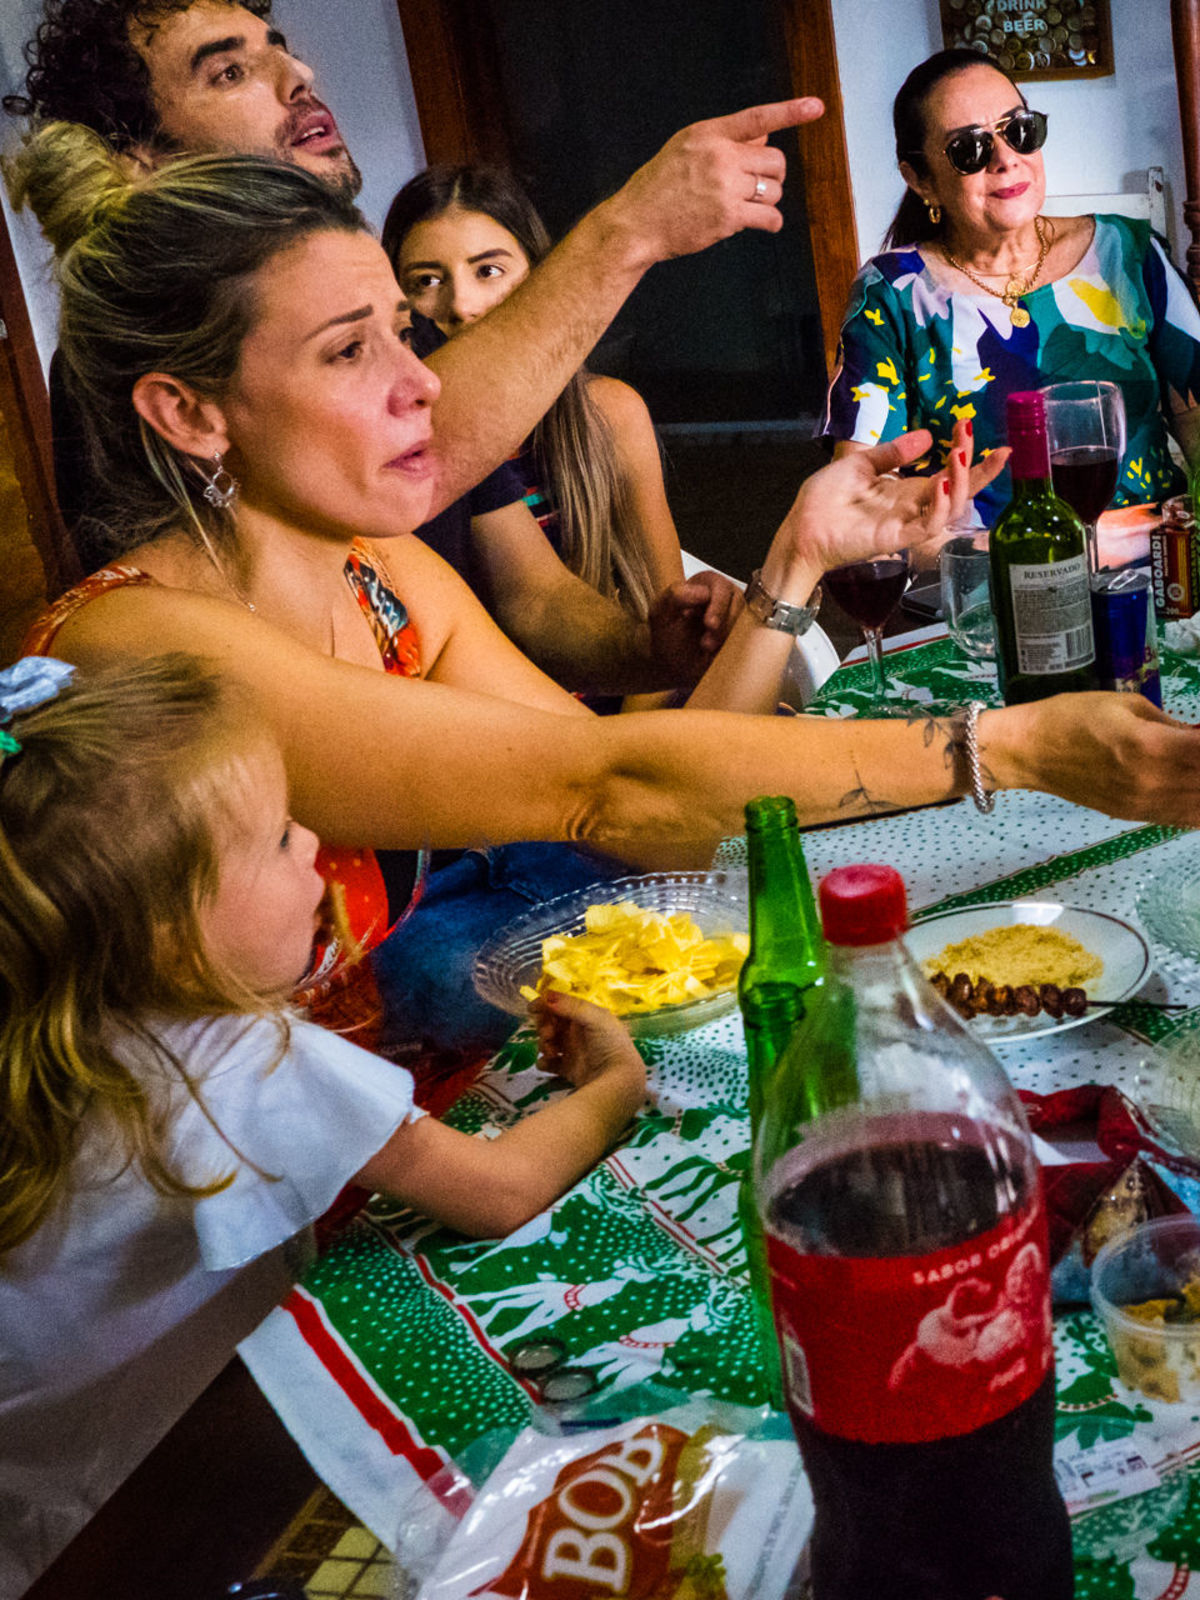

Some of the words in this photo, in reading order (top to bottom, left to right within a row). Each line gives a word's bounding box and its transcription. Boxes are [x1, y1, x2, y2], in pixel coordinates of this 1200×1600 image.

[996, 0, 1047, 12] DRINK
[1003, 18, 1046, 33] BEER
[1023, 562, 1081, 580] RESERVADO
[1151, 534, 1166, 608] GABOARDI
[912, 1253, 983, 1285] SABOR
